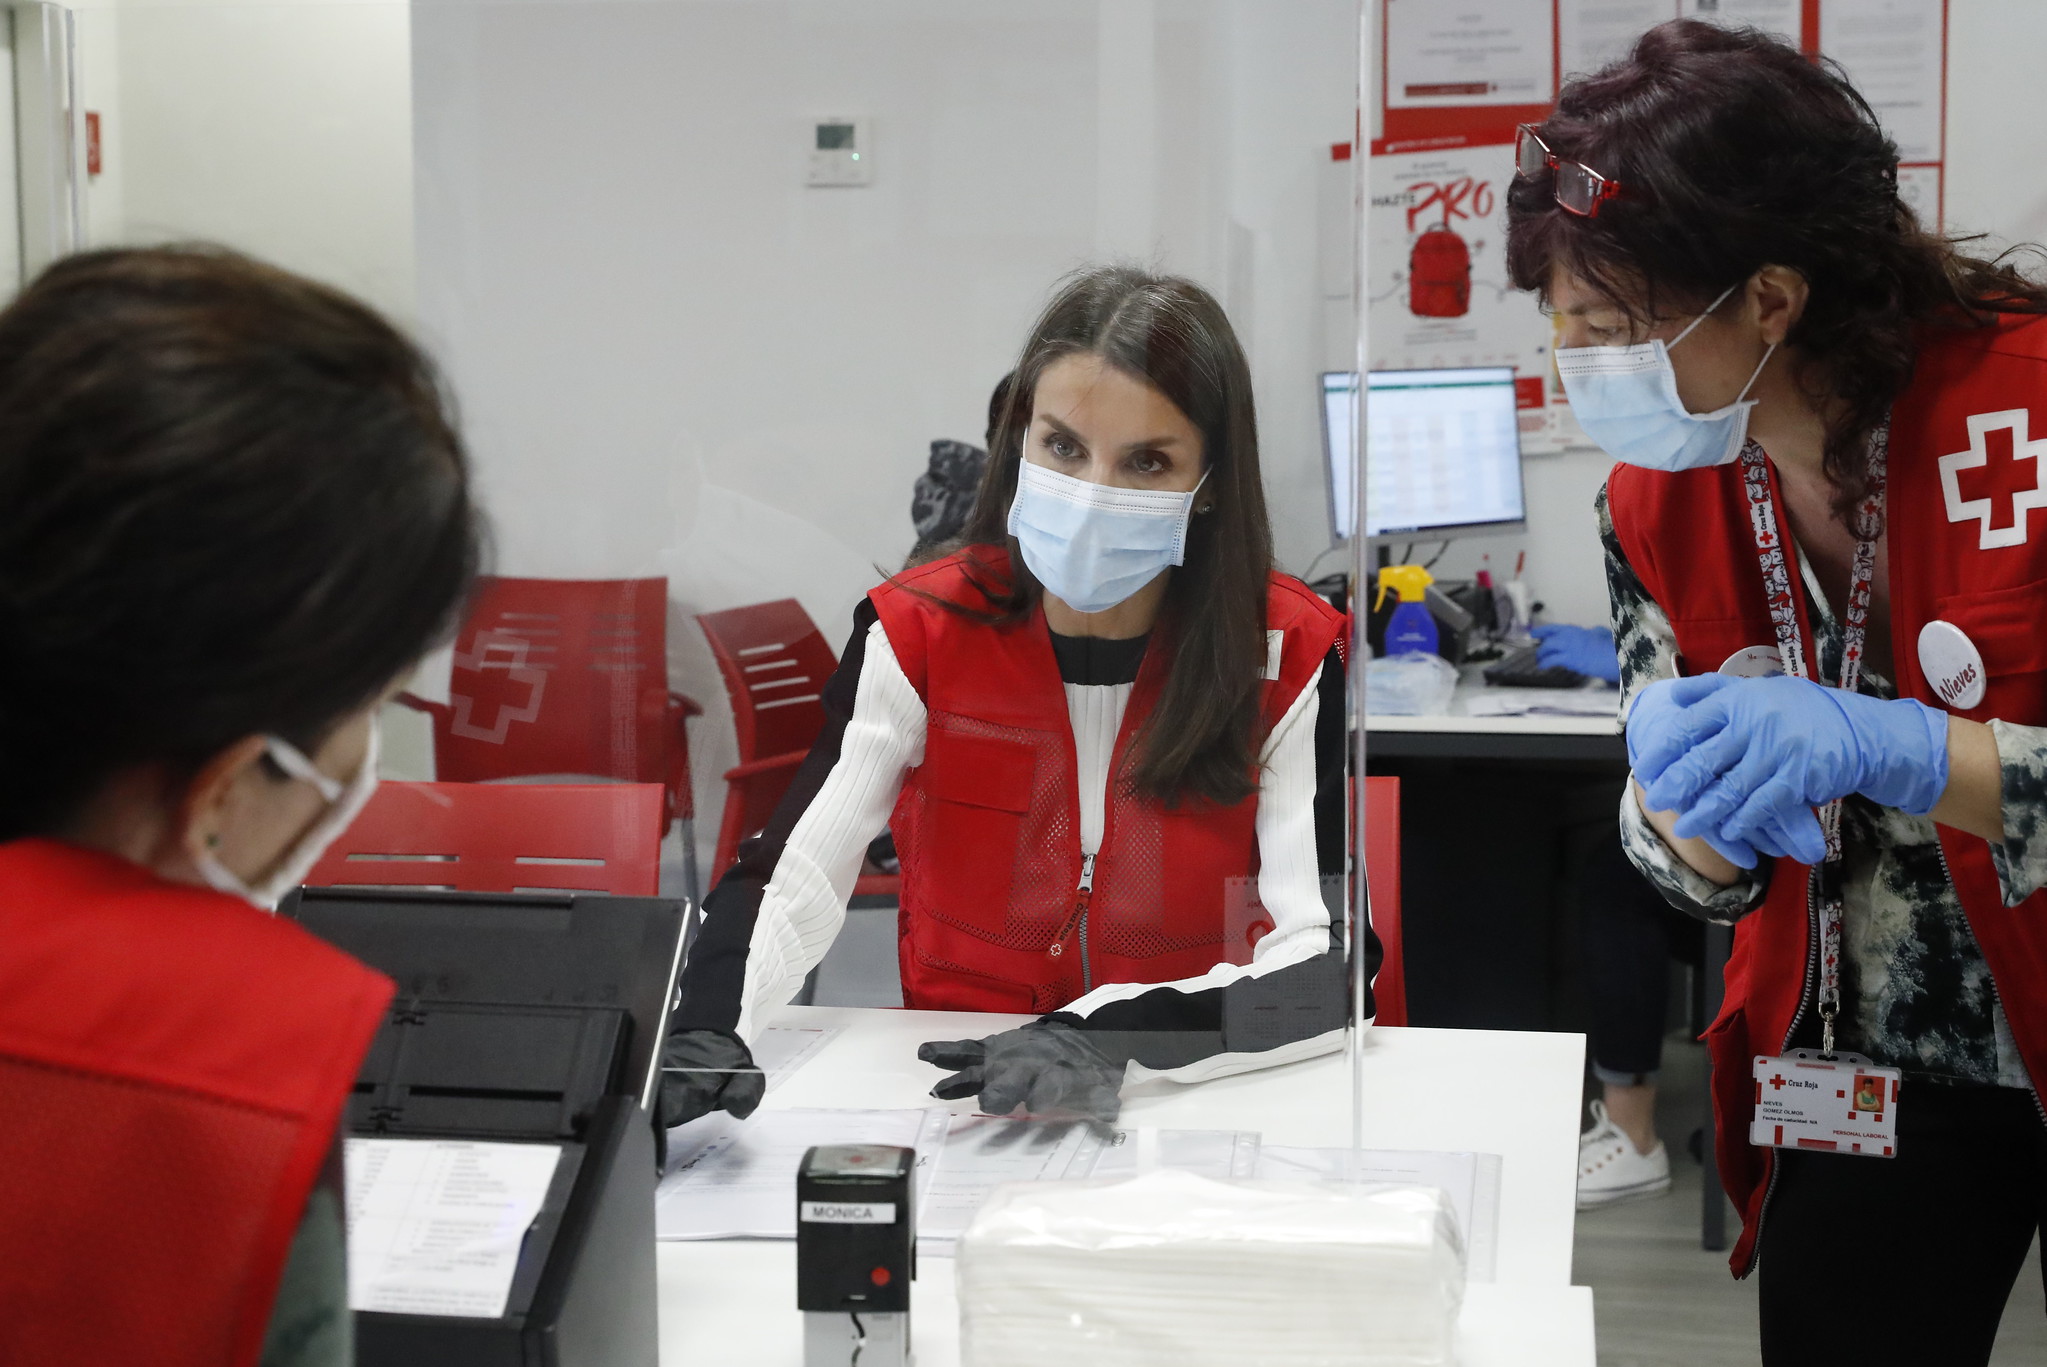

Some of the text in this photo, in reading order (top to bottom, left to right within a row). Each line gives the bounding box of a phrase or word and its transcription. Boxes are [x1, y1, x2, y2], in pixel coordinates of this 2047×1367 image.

[1407, 176, 1494, 232] PRO
[1939, 663, 1977, 704] Nieves
[1059, 902, 1084, 941] Cruz Roja
[1788, 1079, 1819, 1090] Cruz Roja
[1832, 1129, 1889, 1140] PERSONAL LABORAL
[812, 1206, 873, 1219] MONICA
